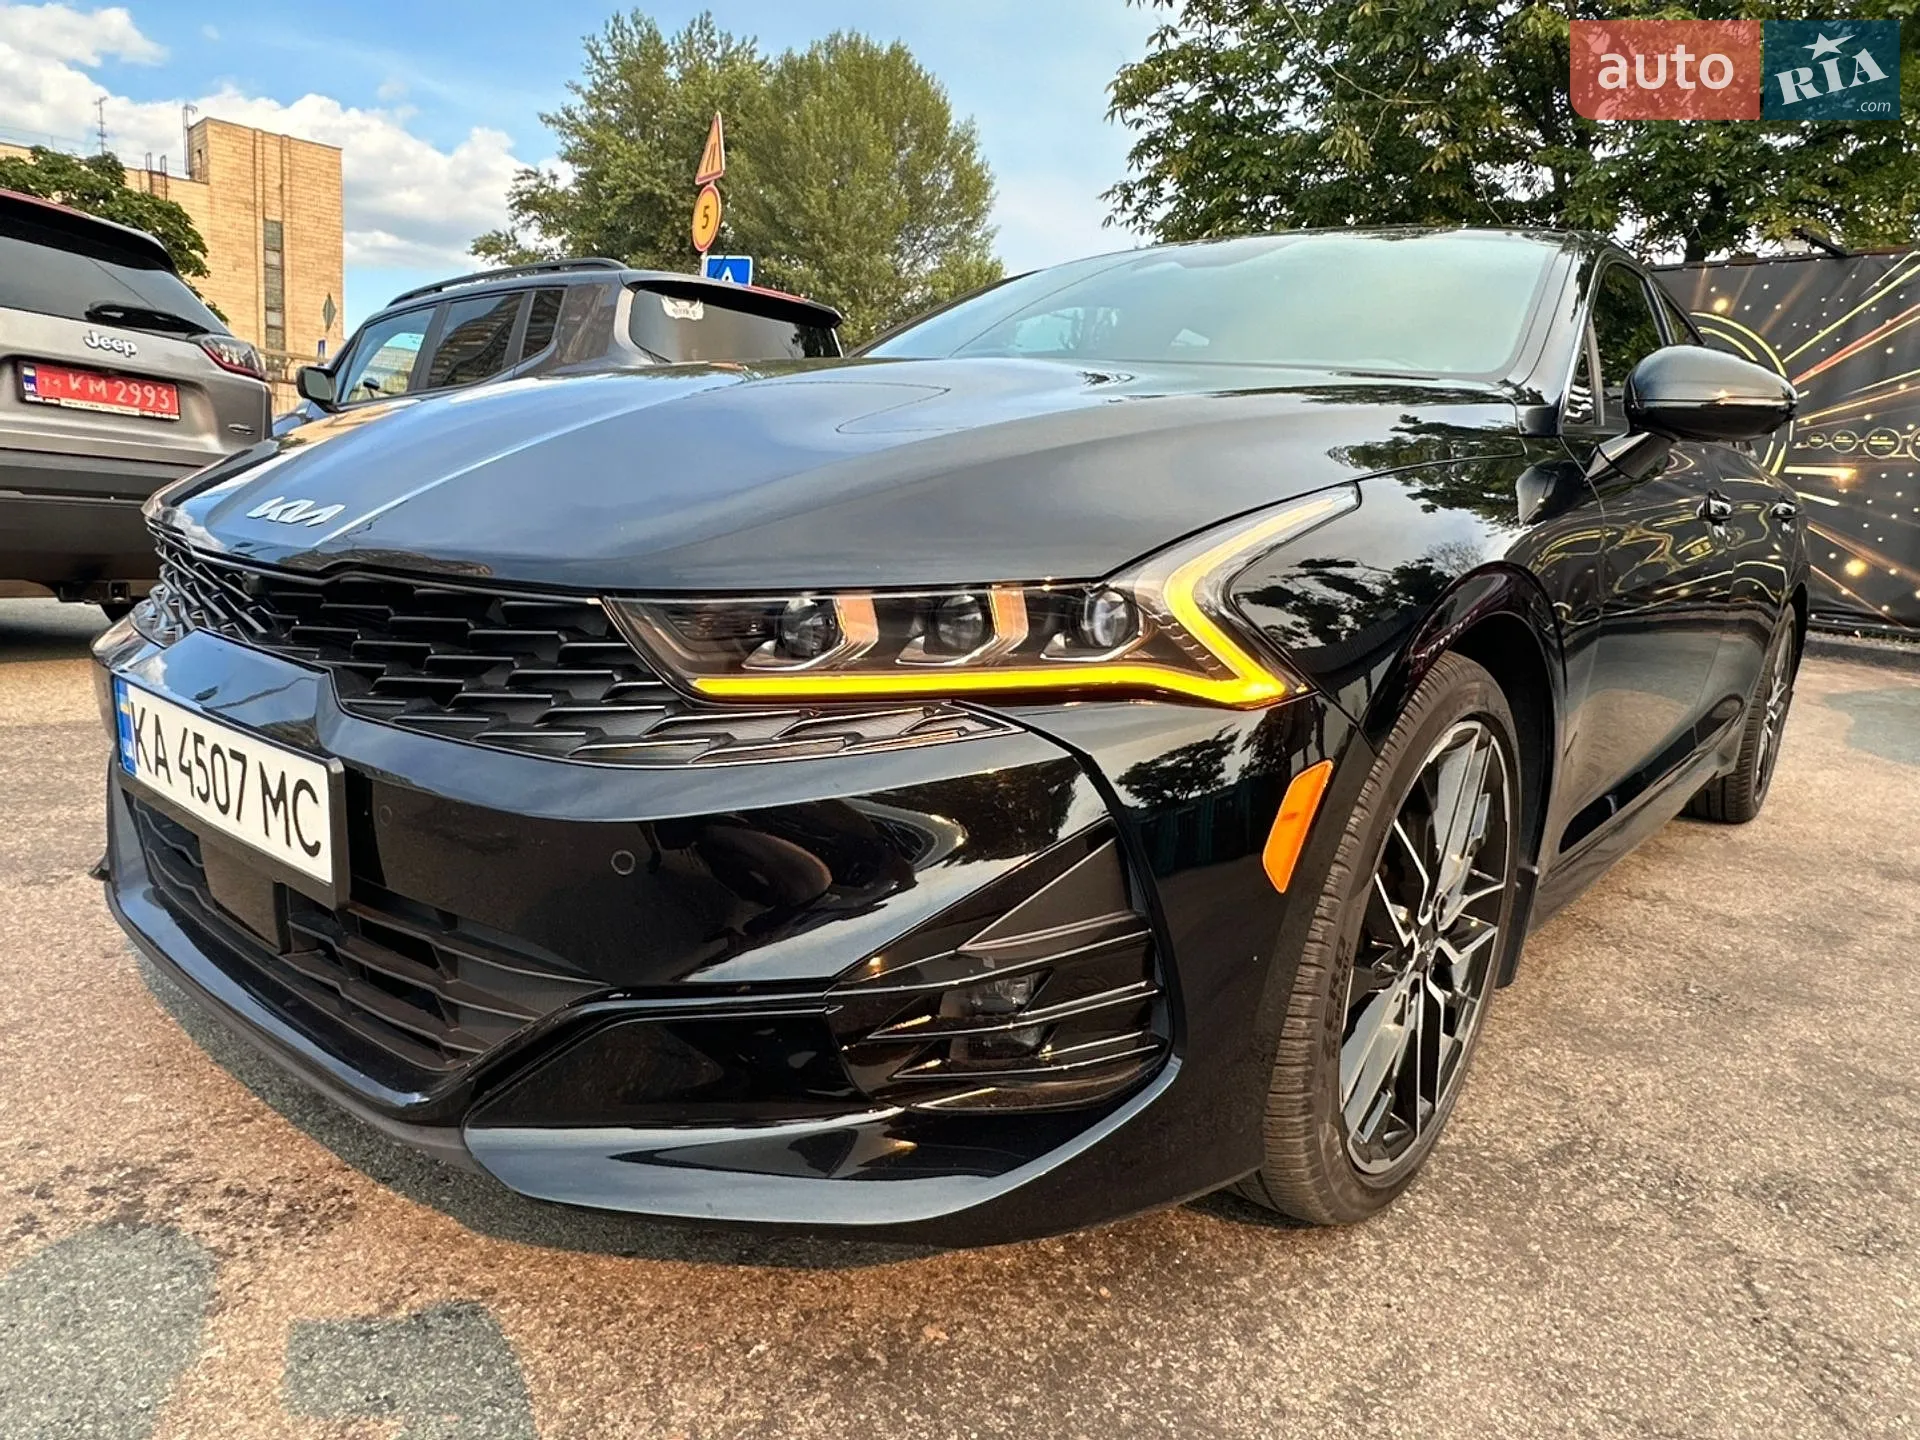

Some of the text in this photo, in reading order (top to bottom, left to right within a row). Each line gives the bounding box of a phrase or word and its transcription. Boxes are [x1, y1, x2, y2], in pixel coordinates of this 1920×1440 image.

[701, 205, 711, 230] 5
[82, 329, 138, 358] Jeep
[67, 372, 108, 400] KM
[114, 380, 171, 410] 2993
[245, 495, 346, 528] KIA
[130, 701, 322, 858] KA 4507 MC
